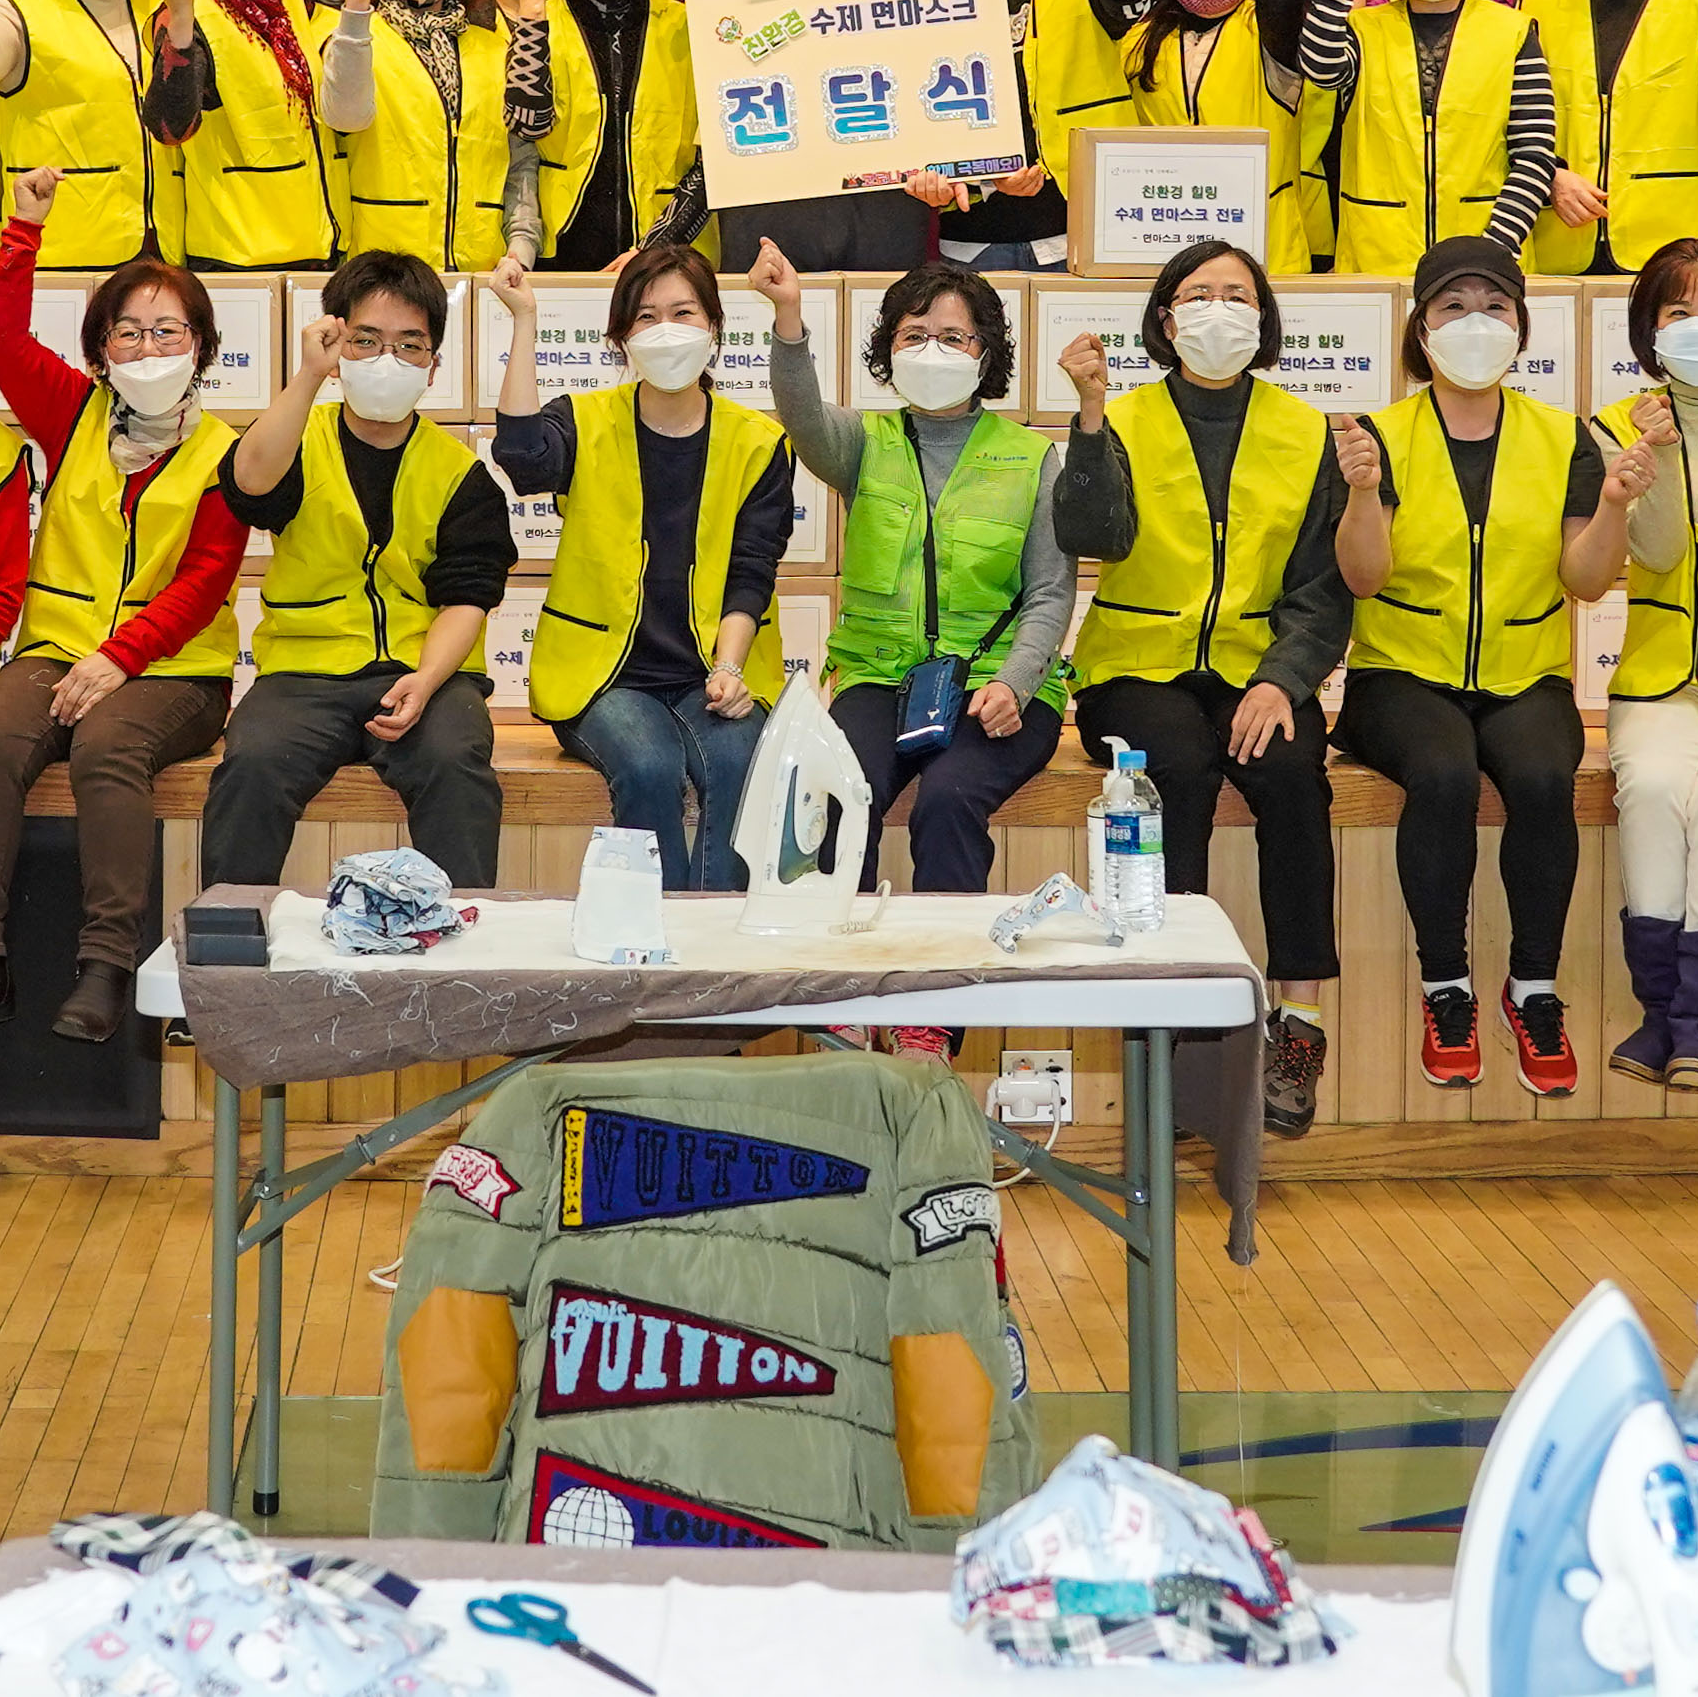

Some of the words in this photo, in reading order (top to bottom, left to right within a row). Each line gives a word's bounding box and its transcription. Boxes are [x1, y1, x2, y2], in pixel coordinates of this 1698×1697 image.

[741, 8, 806, 59] 친환경
[810, 3, 863, 35] 수제
[1142, 185, 1183, 200] 친환경
[1191, 185, 1218, 200] 힐링
[1115, 207, 1144, 222] 수제
[1151, 207, 1208, 222] 면마스크
[1216, 207, 1245, 222] 전달
[1143, 233, 1181, 243] 면마스크
[535, 329, 566, 344] 환경
[574, 329, 601, 344] 힐링
[1283, 334, 1310, 348] 환경
[1318, 334, 1344, 348] 힐링
[222, 352, 251, 367] 전달
[535, 351, 592, 366] 면마스크
[723, 353, 770, 368] 면마스
[1107, 355, 1150, 370] 마스크
[1279, 356, 1335, 371] 면마스크
[1343, 356, 1371, 371] 전달
[1527, 359, 1556, 373] 전달
[1611, 360, 1641, 375] 수제
[570, 378, 598, 388] 의병단
[715, 380, 753, 390] 면마스크
[1313, 382, 1342, 393] 의병단
[494, 650, 523, 666] 수제
[591, 1117, 853, 1211] VUITTON
[553, 1310, 818, 1396] VUITTON
